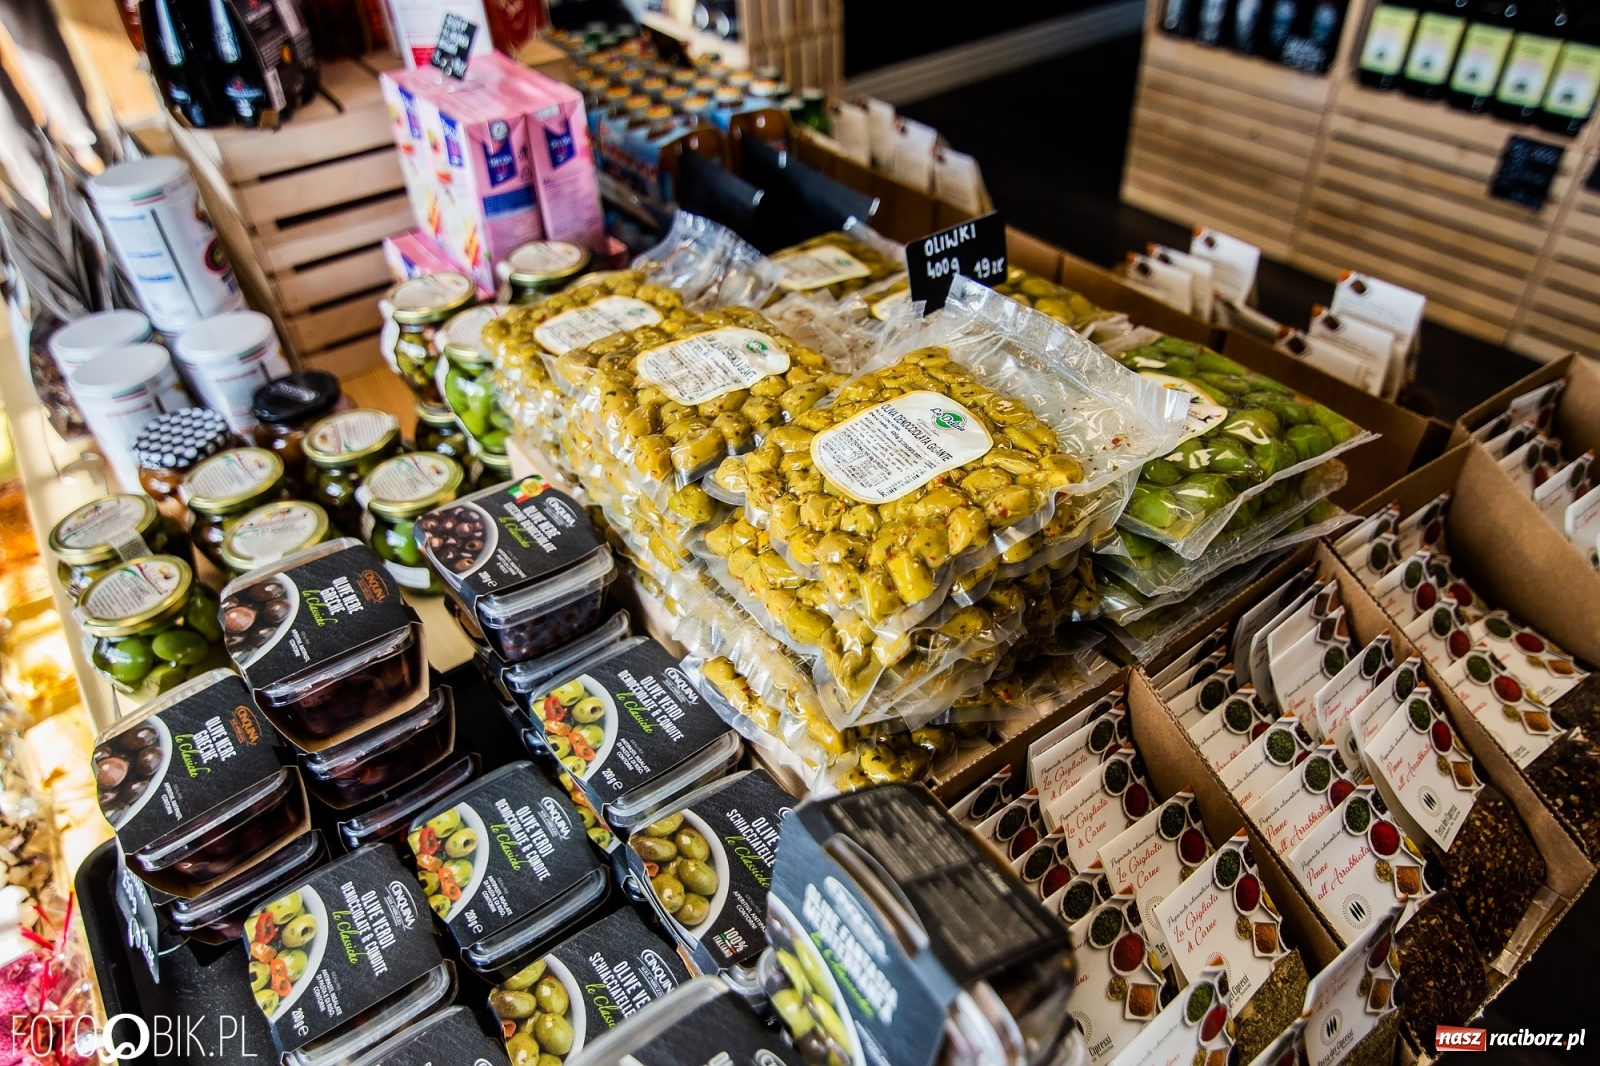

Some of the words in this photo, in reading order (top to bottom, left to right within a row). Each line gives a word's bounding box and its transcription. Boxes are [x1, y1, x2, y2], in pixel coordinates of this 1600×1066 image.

[924, 223, 976, 256] OLIWKI
[927, 257, 960, 279] 400g
[894, 413, 929, 447] DENOCCIOLATA
[926, 440, 954, 462] GIGANTE
[523, 505, 547, 524] OLIVE
[538, 520, 561, 539] NERE
[320, 587, 346, 616] GRECHE
[332, 576, 354, 597] OLIVE
[342, 594, 364, 615] NERE
[618, 670, 658, 711] DENOCCIOLATE
[640, 676, 665, 699] OLIVE
[658, 695, 685, 721] VERDI
[667, 670, 698, 702] CINQUINA
[205, 716, 228, 738] OLIVE
[624, 701, 662, 734] Classiche
[651, 709, 662, 717] &
[656, 715, 684, 742] CONDITE
[180, 743, 210, 777] Classiche
[193, 730, 218, 764] GRECHE
[215, 737, 237, 762] NERE
[602, 768, 616, 785] 200g
[1054, 755, 1088, 782] Grigliata
[1386, 757, 1403, 778] Penne
[495, 798, 530, 846] DENOCCIOLATE
[543, 800, 571, 837] CINQUINA
[1076, 798, 1108, 829] Grigliata
[1290, 804, 1330, 846] Arrabbiata
[516, 805, 540, 832] OLIVE
[531, 827, 555, 858] VERDI
[725, 835, 746, 846] le
[726, 809, 776, 868] SCHIACCIATELLE
[751, 816, 781, 847] OLIVE
[1085, 821, 1107, 843] Carne
[1265, 820, 1287, 842] Penne
[497, 833, 531, 871] Classiche
[521, 843, 534, 853] &
[1116, 867, 1127, 884] La
[1128, 842, 1163, 874] Grigliata
[525, 850, 551, 882] CONDITE
[734, 846, 773, 888] Classiche
[1136, 866, 1160, 888] Carne
[1306, 862, 1328, 886] Penne
[1331, 846, 1370, 890] Arrabbiata
[332, 910, 352, 921] le
[340, 881, 371, 936] DENOCCIOLATE
[361, 890, 381, 921] OLIVE
[372, 916, 397, 950] VERDI
[391, 884, 416, 927] CINQUINA
[464, 909, 478, 928] 200g
[736, 904, 757, 929] CONTORNI
[1173, 925, 1185, 943] La
[1185, 893, 1219, 931] Grigliata
[336, 921, 371, 965] Classiche
[360, 933, 373, 944] &
[713, 935, 733, 958] ITALIANO
[724, 927, 748, 953] 100%
[1194, 919, 1217, 946] Carne
[362, 941, 389, 977] CONDITE
[644, 952, 675, 993] CINQUIN
[313, 986, 325, 1012] CONTORNI
[585, 984, 606, 994] le
[589, 952, 637, 1018] SCHIACCIATELLE
[613, 960, 641, 994] OLIVE
[633, 990, 652, 1009] VE
[1232, 972, 1250, 996] Cipressi
[291, 1007, 305, 1030] 200g
[331, 991, 343, 1016] INSALATE
[1088, 1034, 1113, 1057] Cipressi
